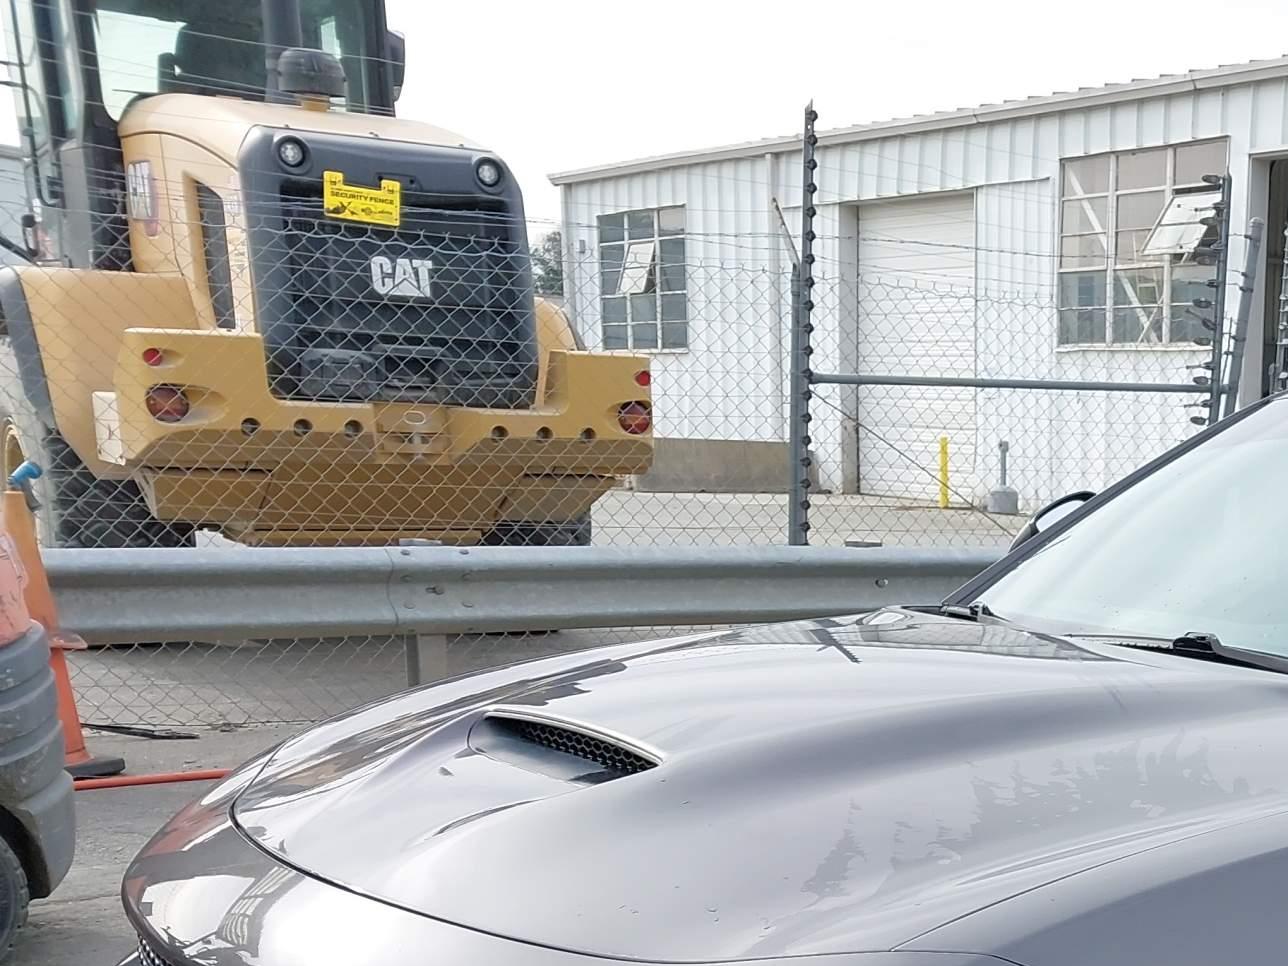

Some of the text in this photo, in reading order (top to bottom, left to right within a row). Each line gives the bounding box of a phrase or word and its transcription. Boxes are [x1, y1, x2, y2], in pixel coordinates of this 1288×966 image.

[330, 190, 369, 202] SECURITY
[369, 196, 395, 206] FENCE
[371, 256, 433, 297] CAT
